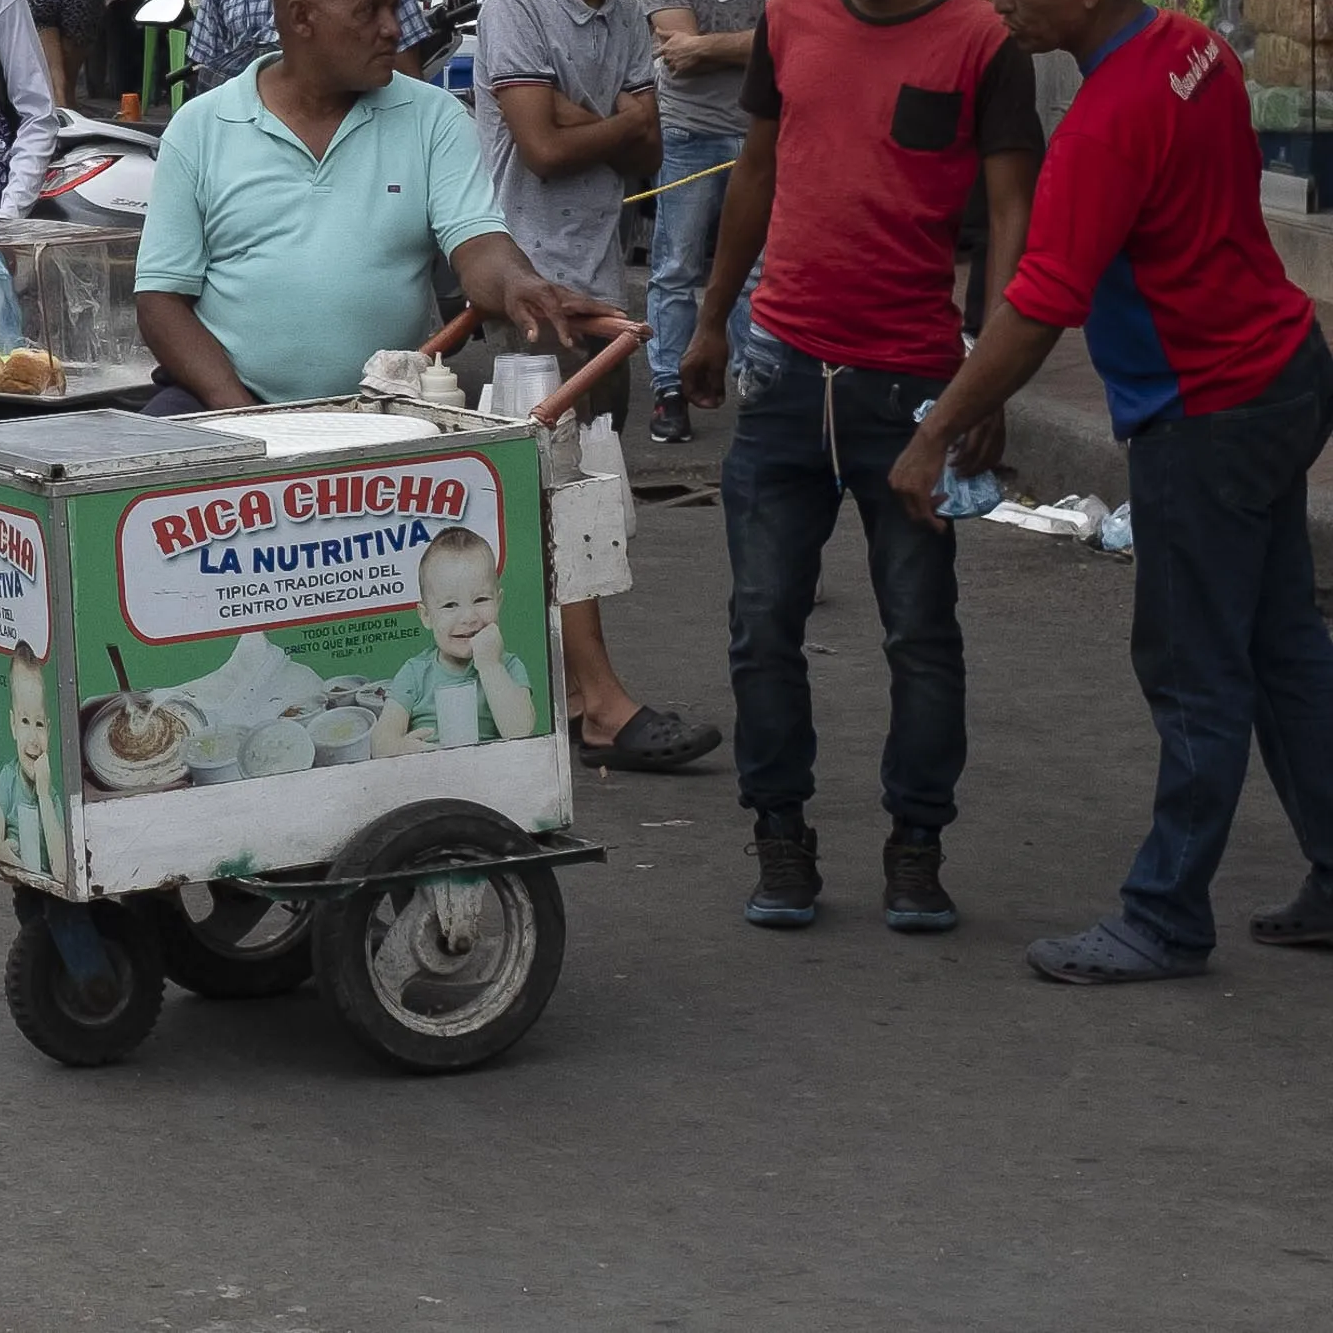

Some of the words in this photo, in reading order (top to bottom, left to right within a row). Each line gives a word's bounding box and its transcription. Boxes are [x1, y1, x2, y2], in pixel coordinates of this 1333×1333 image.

[152, 489, 274, 557] RICA
[283, 474, 468, 519] CHICHA
[200, 546, 242, 575] LA
[253, 519, 432, 574] NUTRITIVA
[215, 582, 270, 601] TIPICA
[274, 569, 364, 592] TRADICION
[368, 564, 402, 579] DEL
[219, 596, 288, 619] CENTRO
[292, 581, 405, 609] VENEZOLANO
[284, 642, 320, 656] CRISTO
[322, 640, 344, 651] QUE
[345, 635, 360, 647] ME
[361, 627, 421, 644] FORTALECE
[301, 628, 330, 641] TODO
[332, 624, 346, 635] LO
[348, 619, 382, 634] PUEDO
[384, 617, 398, 628] EN
